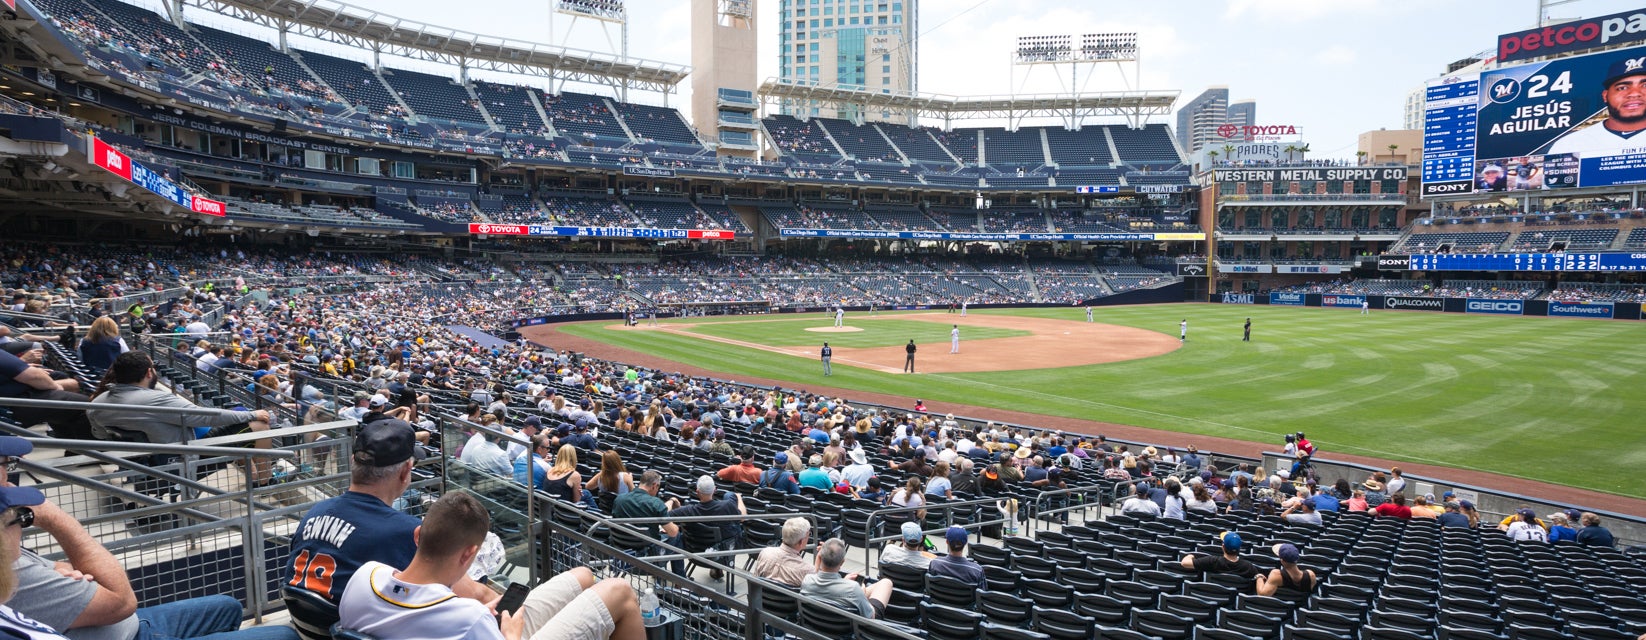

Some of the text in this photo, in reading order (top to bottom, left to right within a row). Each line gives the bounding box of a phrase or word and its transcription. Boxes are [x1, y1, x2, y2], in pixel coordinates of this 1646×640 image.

[1528, 71, 1572, 98] 24
[1510, 100, 1572, 120] JESÚS
[1242, 125, 1296, 135] TOYOTA
[1489, 116, 1570, 135] AGUILAR
[152, 113, 350, 155] JERRY COLEMAN BROADCAST CENTER
[1237, 145, 1279, 158] PADRES
[1216, 171, 1274, 181] WESTERN
[1280, 170, 1322, 180] METAL
[1327, 169, 1378, 180] SUPPLY
[1383, 169, 1406, 180] CO.
[1428, 184, 1468, 193] SONY
[202, 200, 220, 214] TOYOTA
[1566, 261, 1597, 269] 2 2 2
[1223, 295, 1252, 304] ASML
[1387, 299, 1441, 309] QUALCOMM
[1468, 302, 1521, 311] GEICO
[1552, 305, 1603, 314] Southwest
[302, 515, 356, 548] GWYNN
